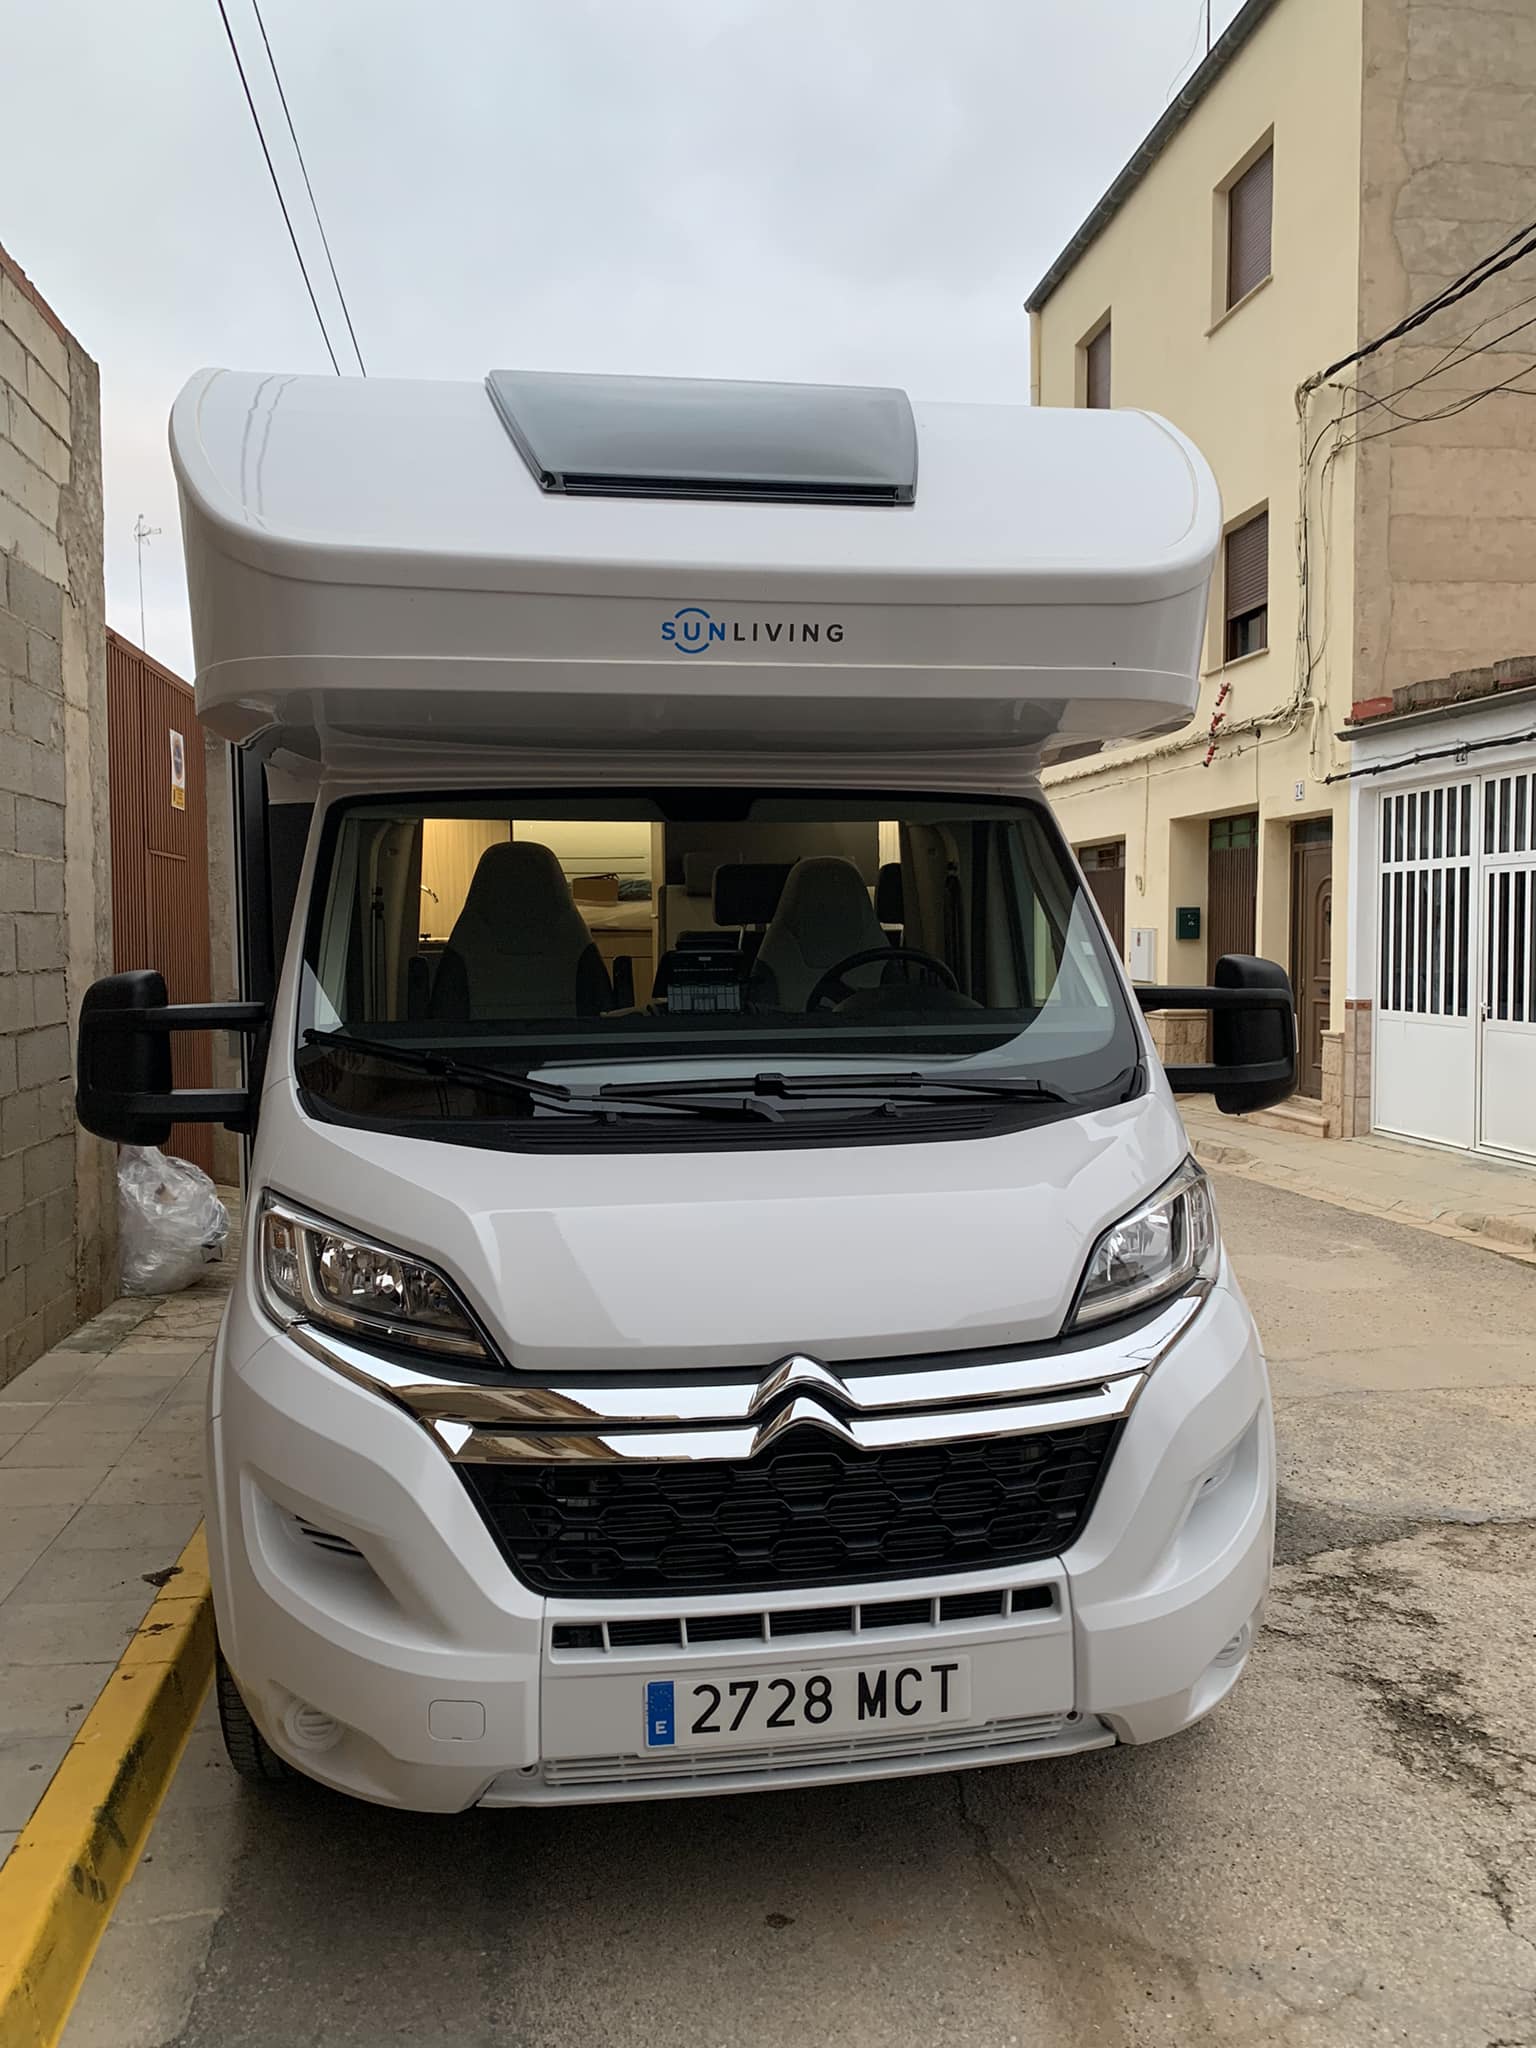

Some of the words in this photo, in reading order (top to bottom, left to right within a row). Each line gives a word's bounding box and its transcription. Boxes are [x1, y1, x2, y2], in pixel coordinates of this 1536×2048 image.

[661, 621, 844, 643] SUNLIVING
[691, 1675, 832, 1734] 2728
[857, 1663, 958, 1720] MCT
[655, 1720, 667, 1734] E
